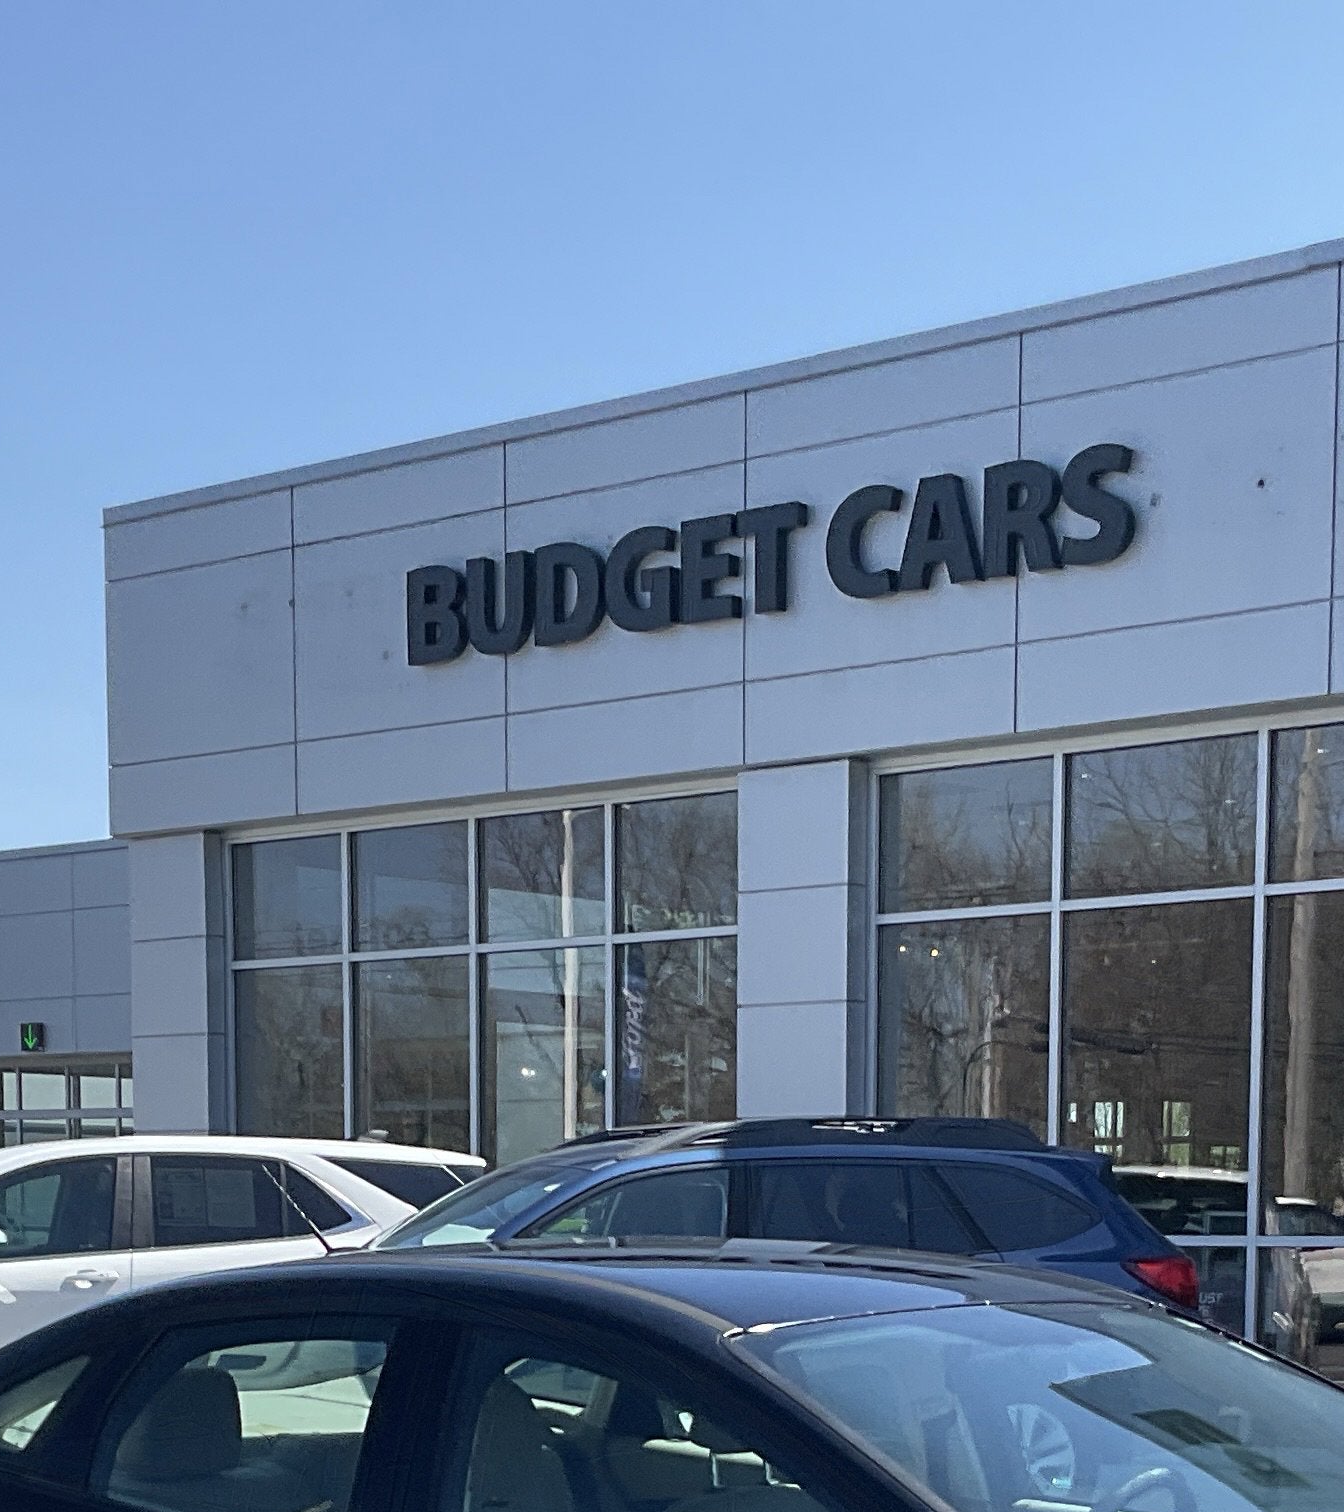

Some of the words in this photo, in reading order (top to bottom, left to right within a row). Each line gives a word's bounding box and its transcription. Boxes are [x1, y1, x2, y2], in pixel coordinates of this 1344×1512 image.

[406, 500, 809, 666] BUDGET
[826, 443, 1135, 599] CARS
[622, 986, 647, 1070] Ford
